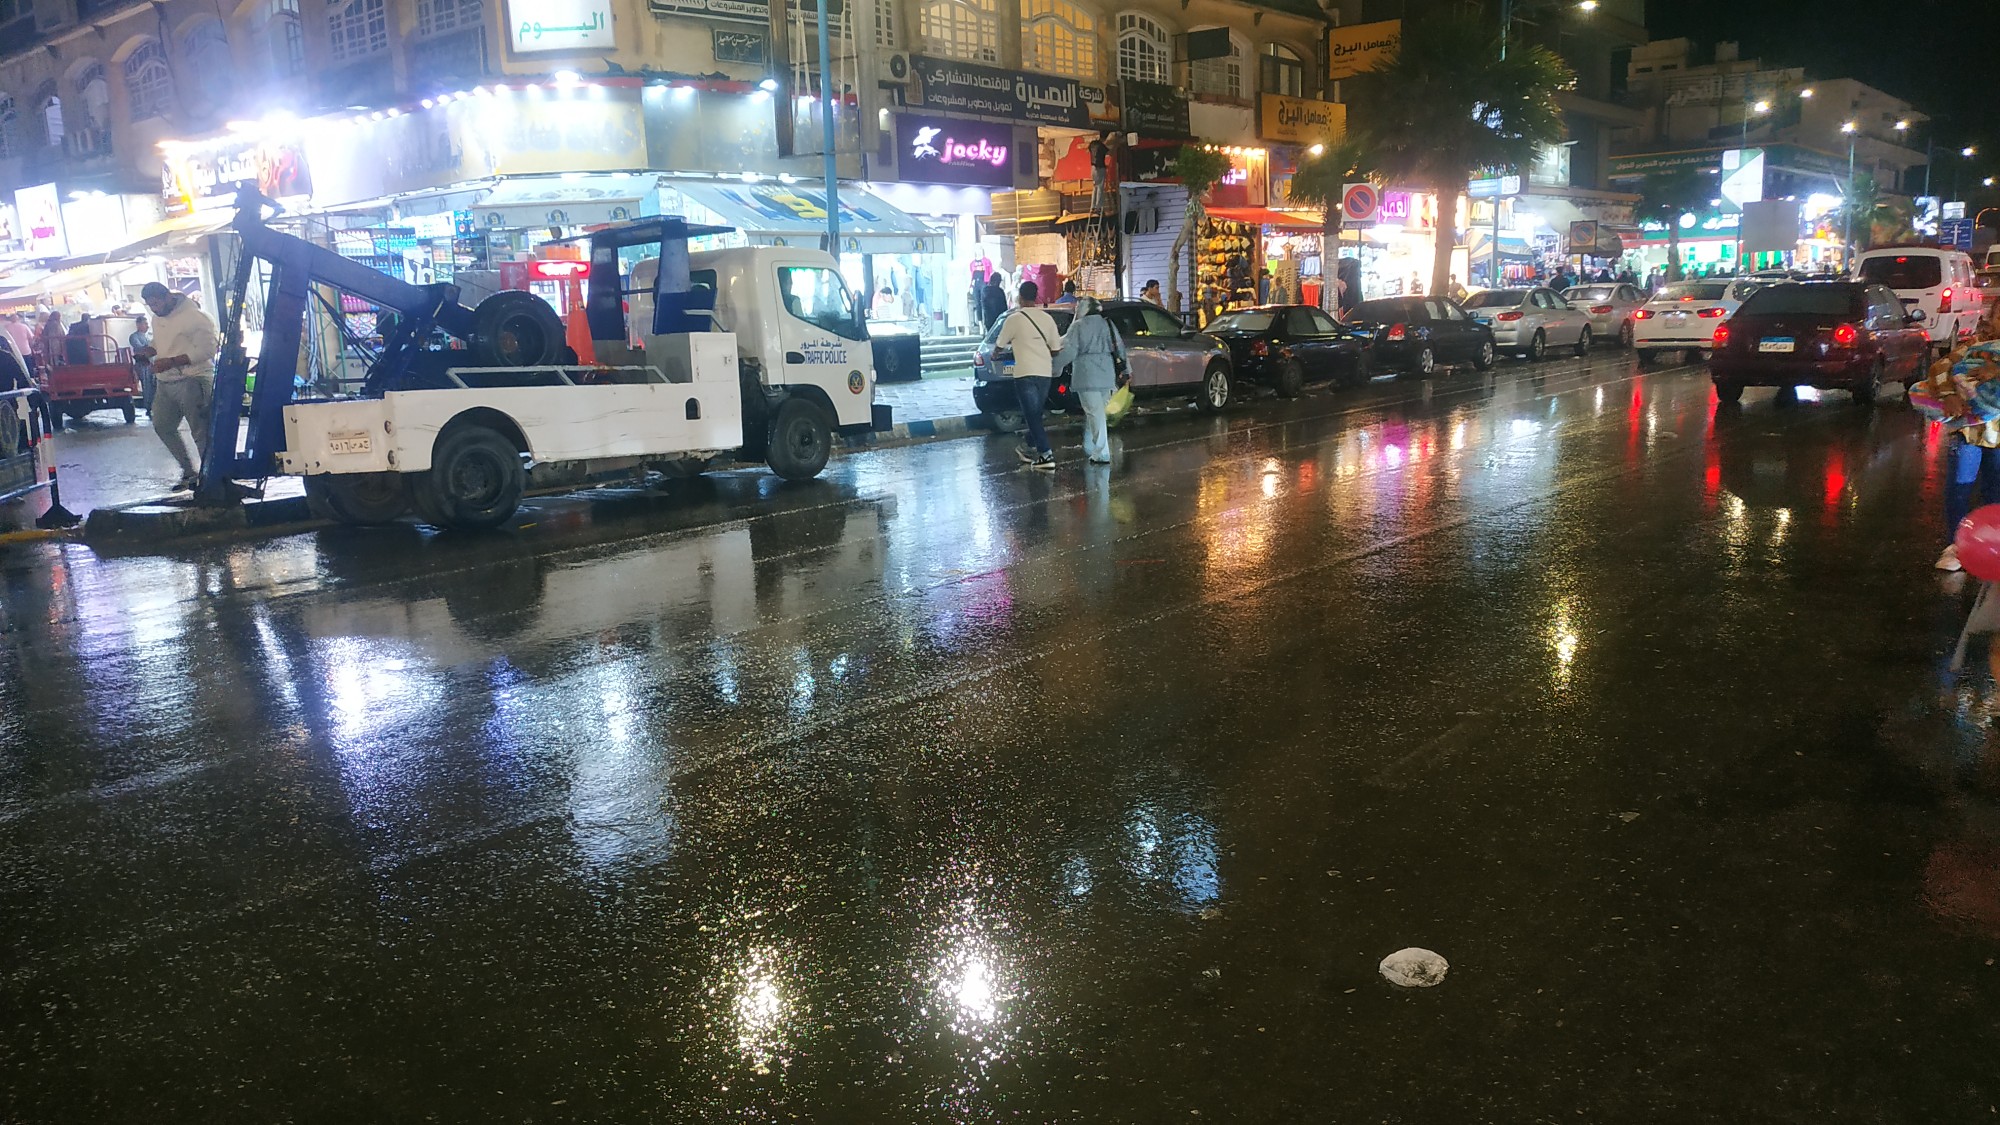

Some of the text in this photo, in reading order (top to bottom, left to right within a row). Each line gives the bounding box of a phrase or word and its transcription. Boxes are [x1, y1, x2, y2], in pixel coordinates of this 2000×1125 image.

[518, 11, 604, 43] اليوم
[1333, 39, 1392, 57] معامل البرج
[928, 93, 967, 107] المشروعات
[1016, 76, 1104, 113] شركة البصيرة
[1278, 101, 1327, 127] معامل البرج
[940, 136, 1007, 166] jacky
[800, 335, 842, 350] شرطة المرور
[804, 350, 847, 364] TRAFFIC POLICE
